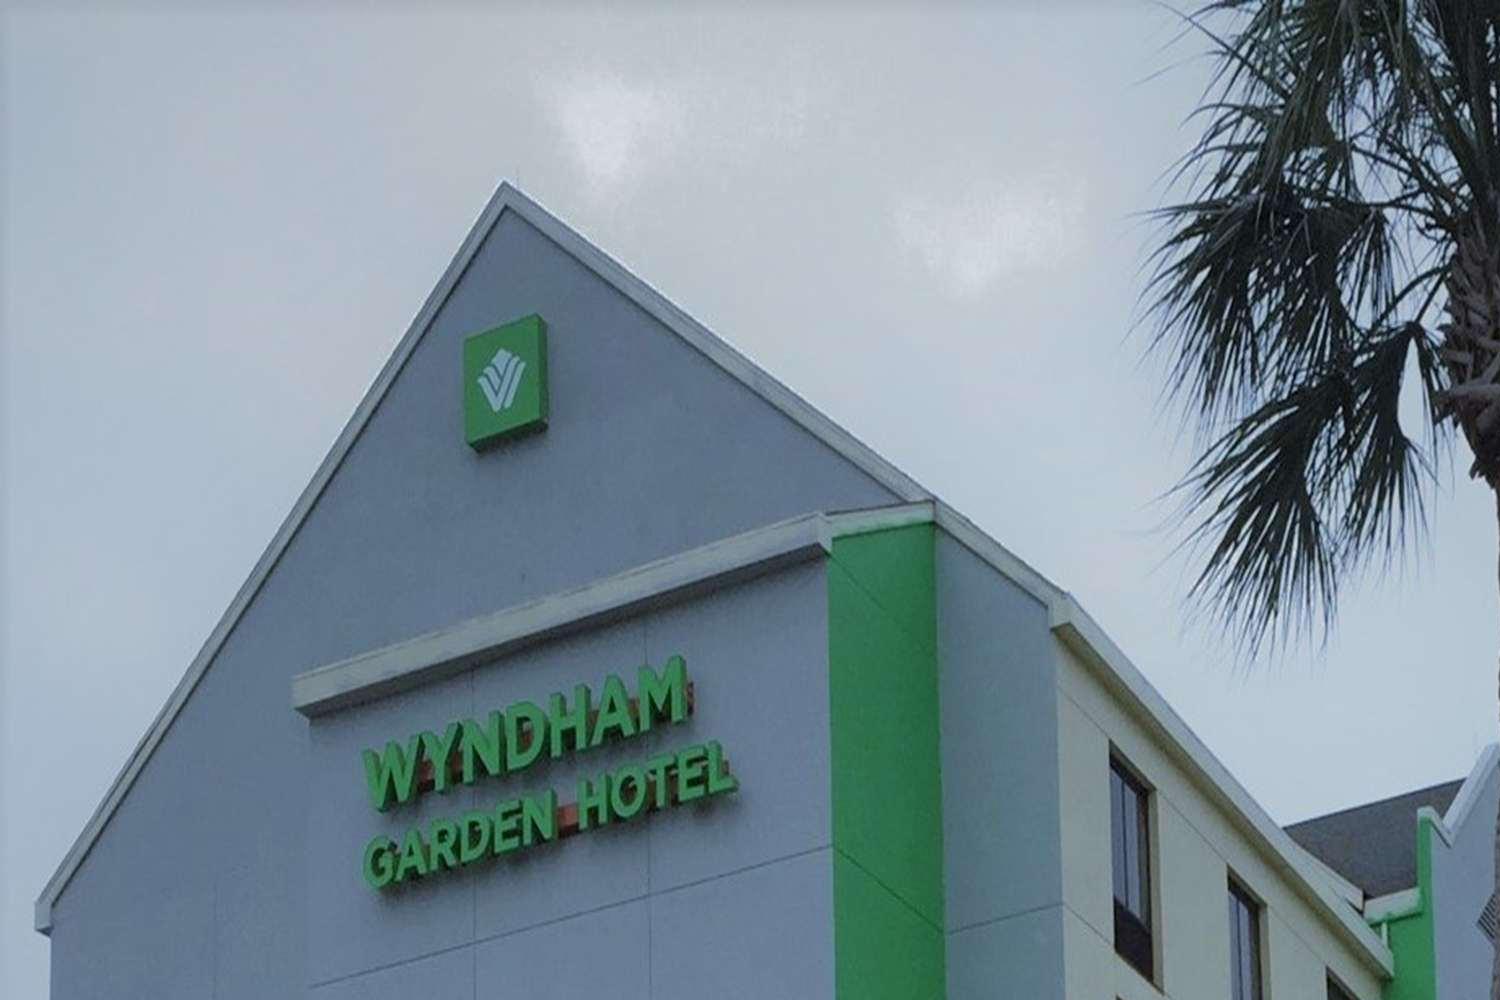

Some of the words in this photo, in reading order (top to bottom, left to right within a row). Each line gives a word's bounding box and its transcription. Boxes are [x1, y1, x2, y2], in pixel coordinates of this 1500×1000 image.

[362, 654, 691, 813] WYNDHAM
[362, 787, 559, 891] GARDEN
[577, 740, 738, 831] HOTEL
